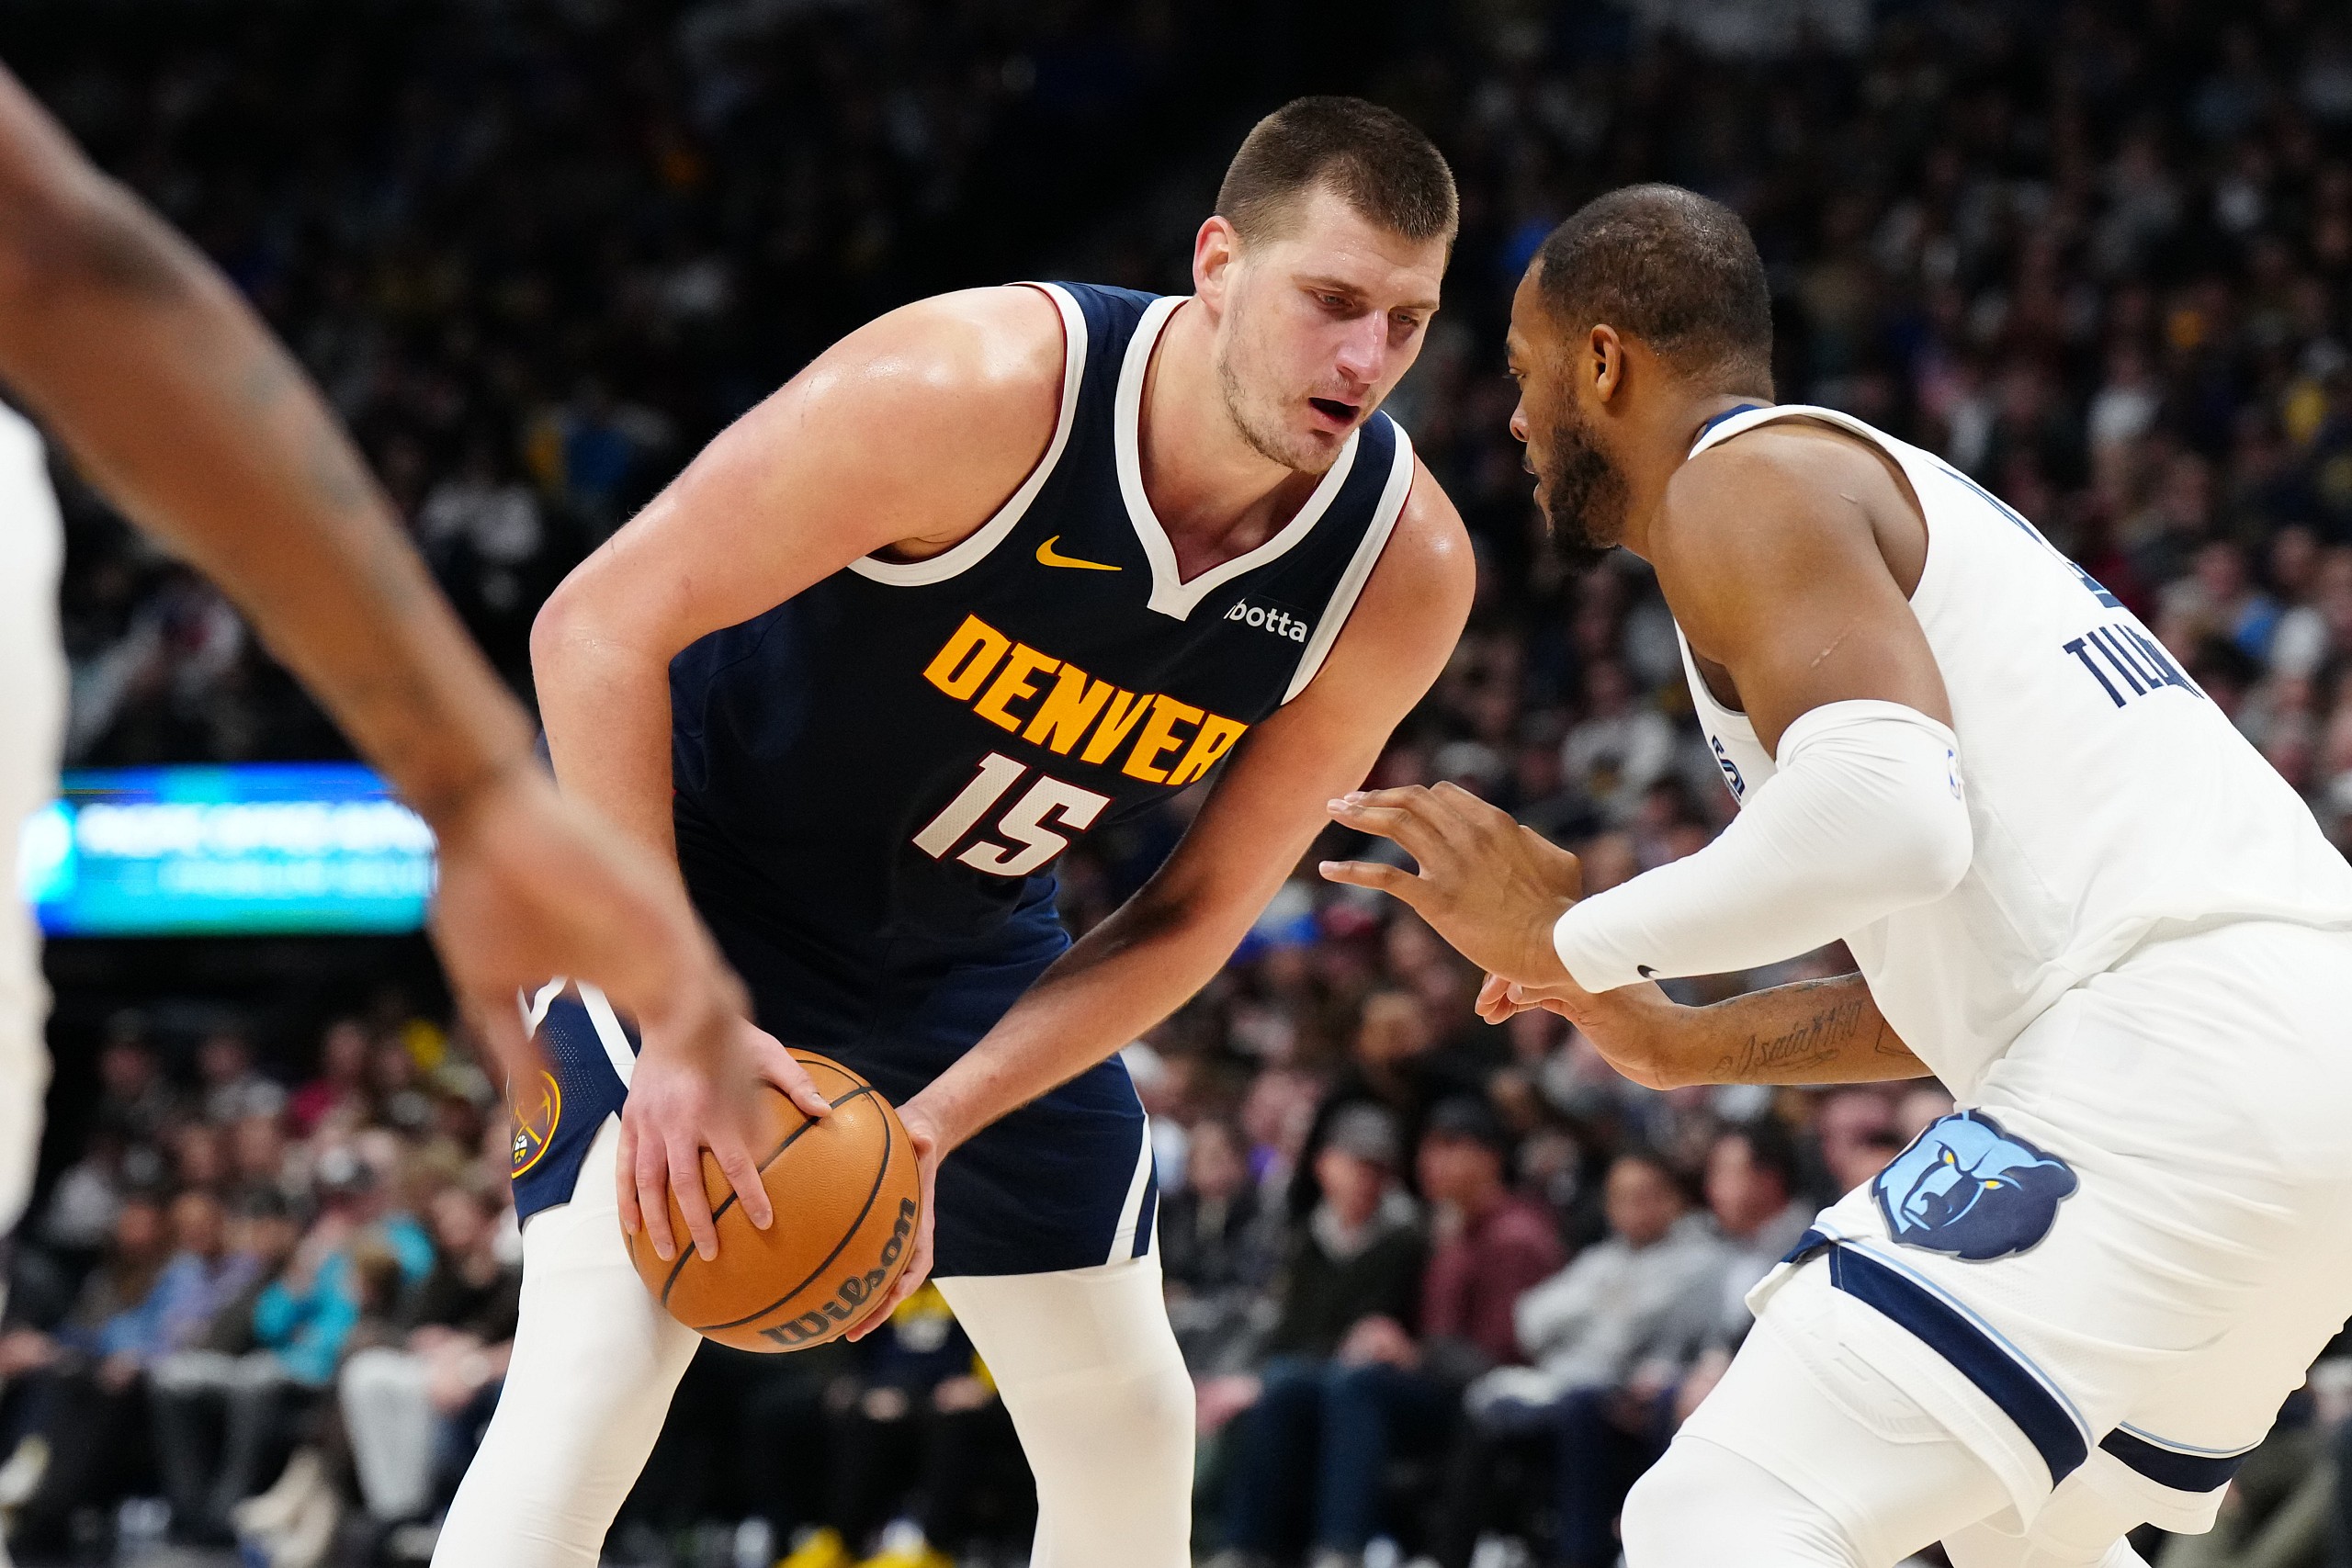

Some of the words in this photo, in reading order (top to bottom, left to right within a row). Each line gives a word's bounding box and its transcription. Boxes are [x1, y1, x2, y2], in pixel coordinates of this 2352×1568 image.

[922, 611, 1250, 786] DENVER
[910, 750, 1114, 877] 15
[759, 1197, 916, 1345] Wilson
